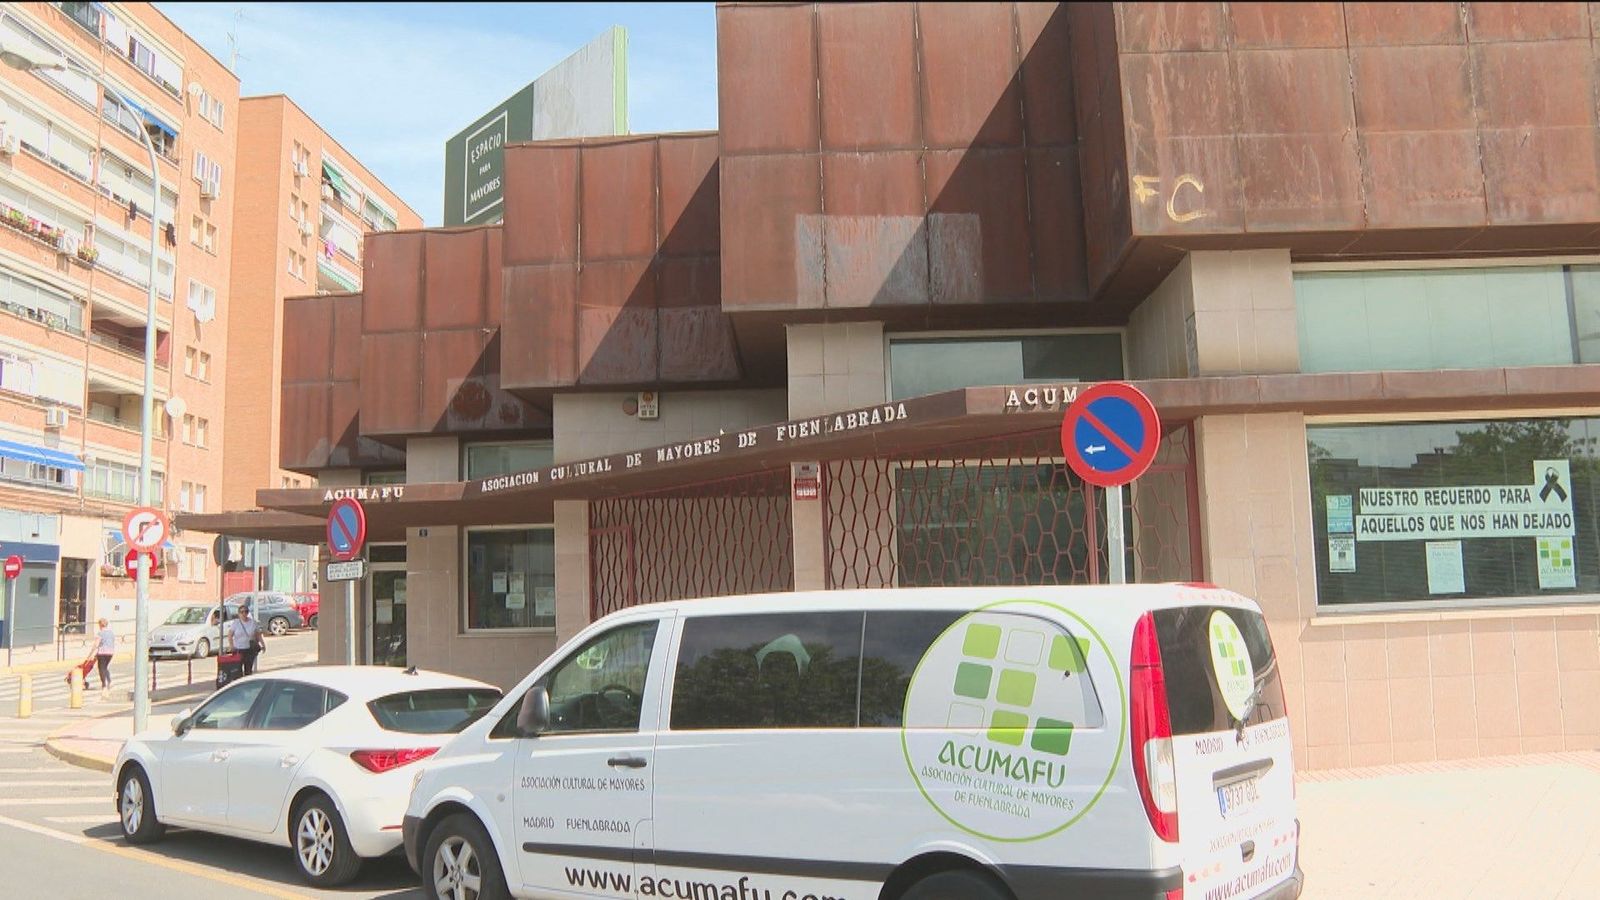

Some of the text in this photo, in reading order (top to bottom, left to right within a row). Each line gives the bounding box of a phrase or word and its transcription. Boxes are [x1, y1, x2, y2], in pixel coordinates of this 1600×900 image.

[471, 133, 501, 163] ESPACIO
[480, 162, 491, 175] PARA
[470, 177, 500, 204] MAYORES
[1006, 386, 1078, 406] ACUM
[481, 403, 908, 492] ASOCIACION CULTURAL DE MAYORES DE FUENLABRADA
[323, 486, 405, 501] ACUMAFU
[1360, 488, 1532, 506] NUESTRO RECUERDO PARA
[1361, 513, 1572, 534] AQUELLOS QUE NOS HAN DEJADO
[938, 740, 1066, 789] ACUMAFU
[521, 776, 645, 791] ASOCIACIÓN CULTURAL DE MAYORES
[921, 765, 1075, 811] ASOCIACIÓN CULTURAL DE MAYORES
[954, 790, 1030, 819] DE FUENLABRADA
[523, 816, 631, 833] MADRID FUENLABRADA
[565, 867, 846, 900] www.acumafu
